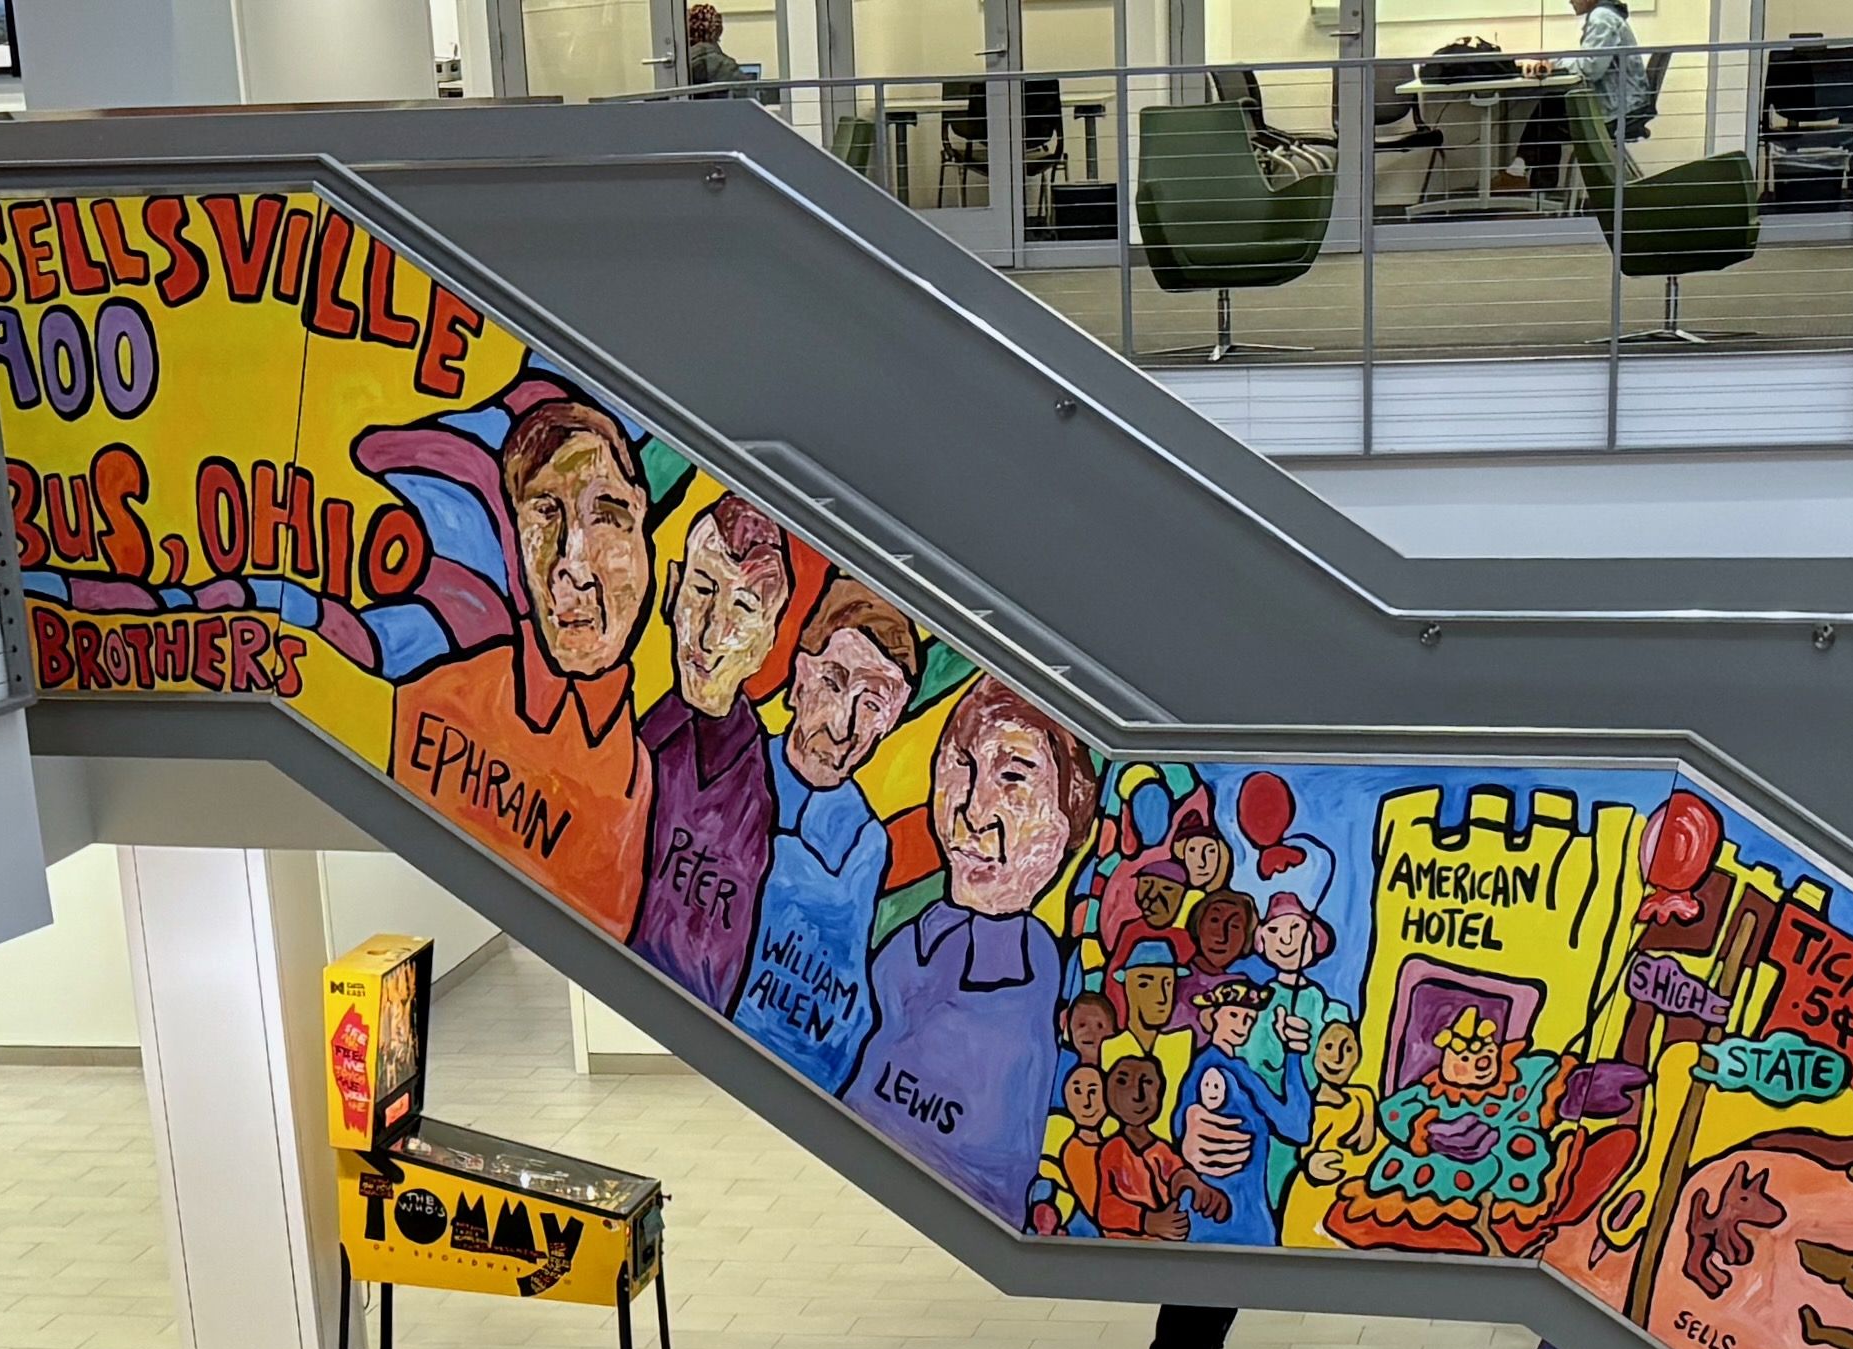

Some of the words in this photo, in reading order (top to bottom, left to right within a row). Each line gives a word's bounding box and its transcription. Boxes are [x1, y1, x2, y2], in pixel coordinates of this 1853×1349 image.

[195, 452, 434, 600] OHIO
[31, 612, 307, 698] BROTHERS
[1387, 851, 1542, 905] AMERICAN
[1400, 905, 1505, 952] HOTEL
[747, 969, 835, 1043] ALLEN
[343, 1060, 365, 1073] ME
[1726, 1046, 1837, 1092] STATE
[874, 1061, 965, 1135] LEWIS
[399, 1202, 446, 1218] WHO'S
[406, 1192, 434, 1207] THE
[358, 1172, 585, 1297] TOMMY
[373, 1244, 395, 1253] ON
[413, 1249, 522, 1273] BROADWAY
